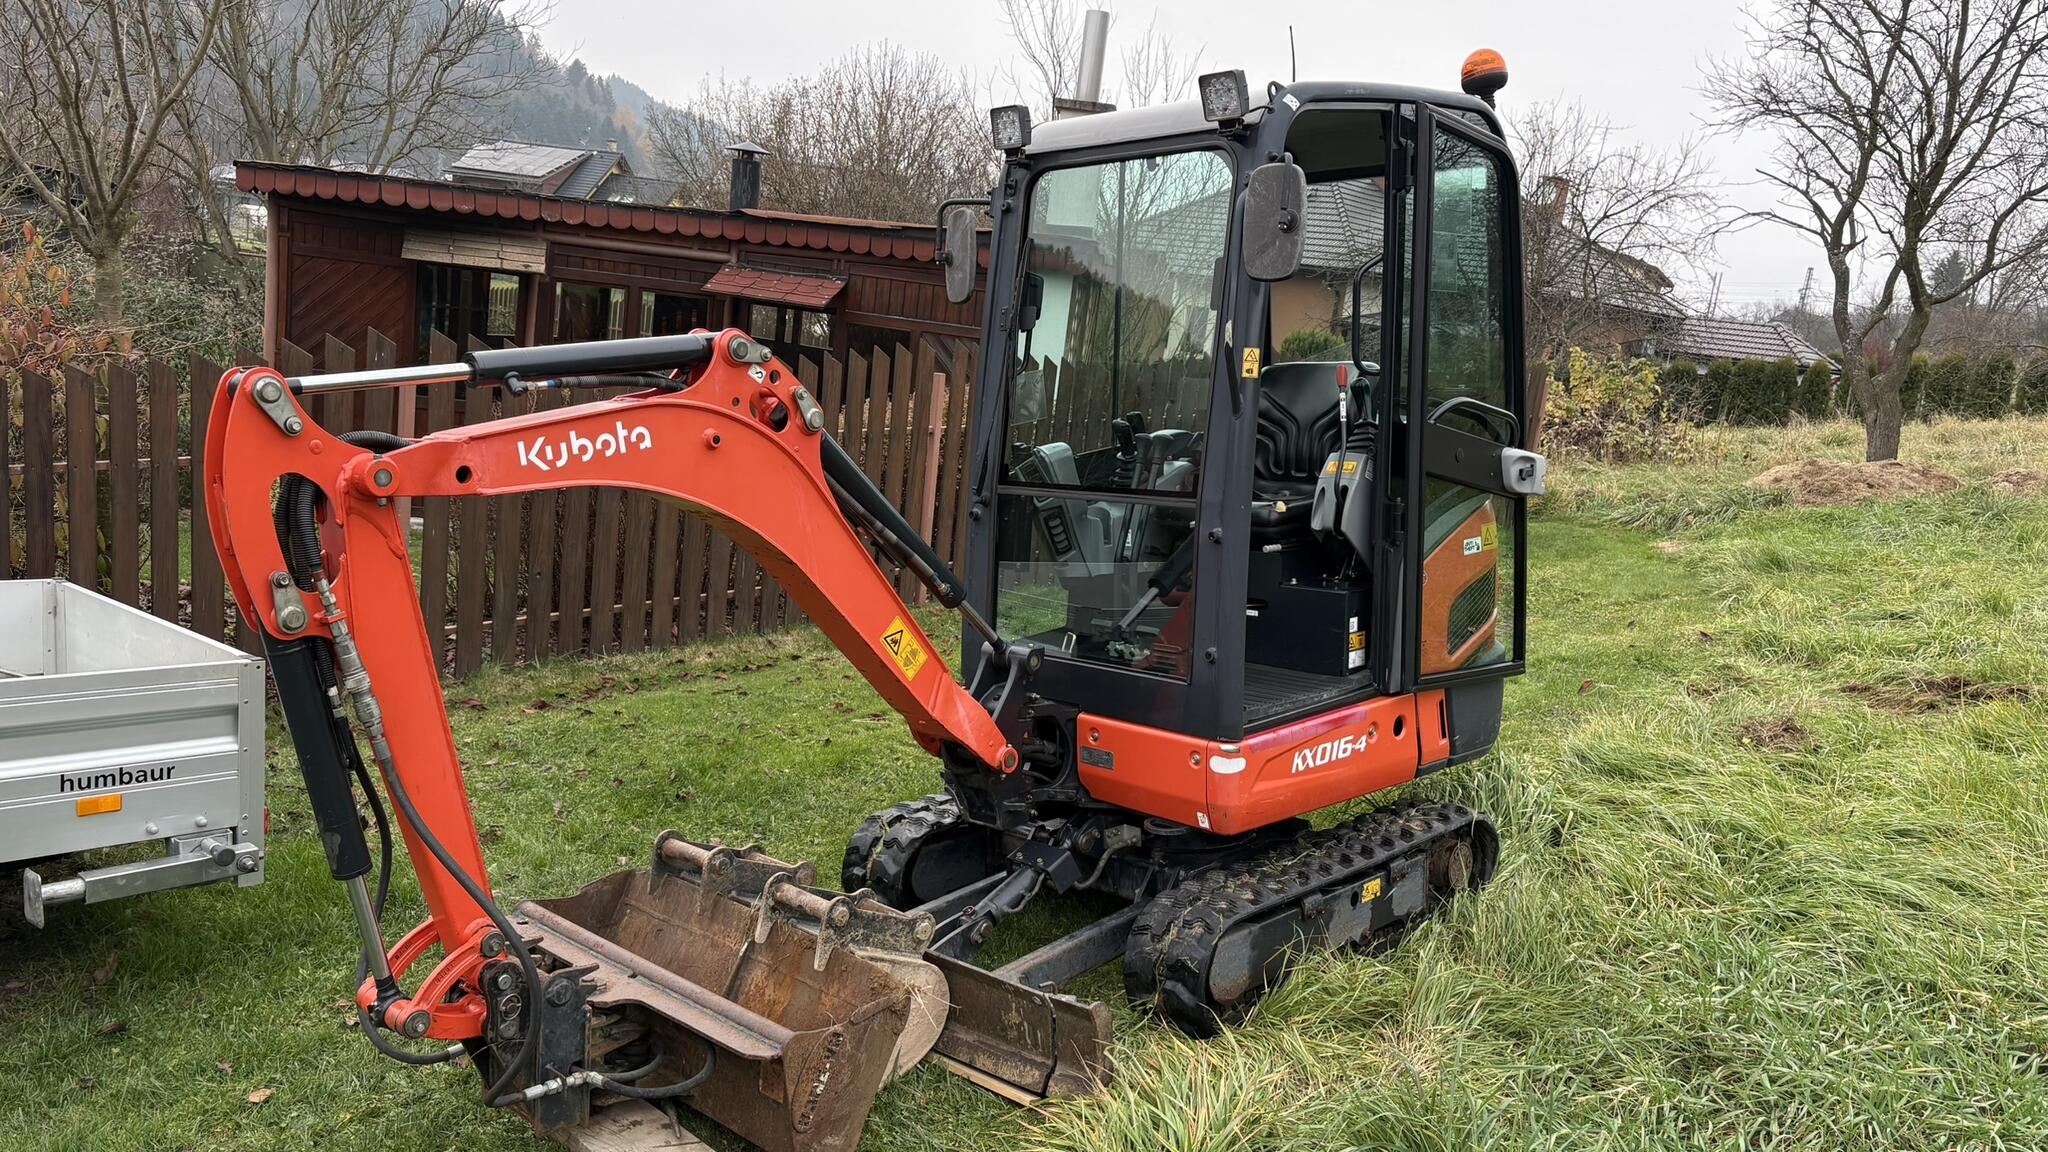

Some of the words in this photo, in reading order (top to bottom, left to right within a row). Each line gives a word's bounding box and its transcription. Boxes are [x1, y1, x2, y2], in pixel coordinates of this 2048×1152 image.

[517, 421, 652, 471] Kubota
[1291, 735, 1367, 774] KX016-4
[60, 765, 176, 793] humbaur
